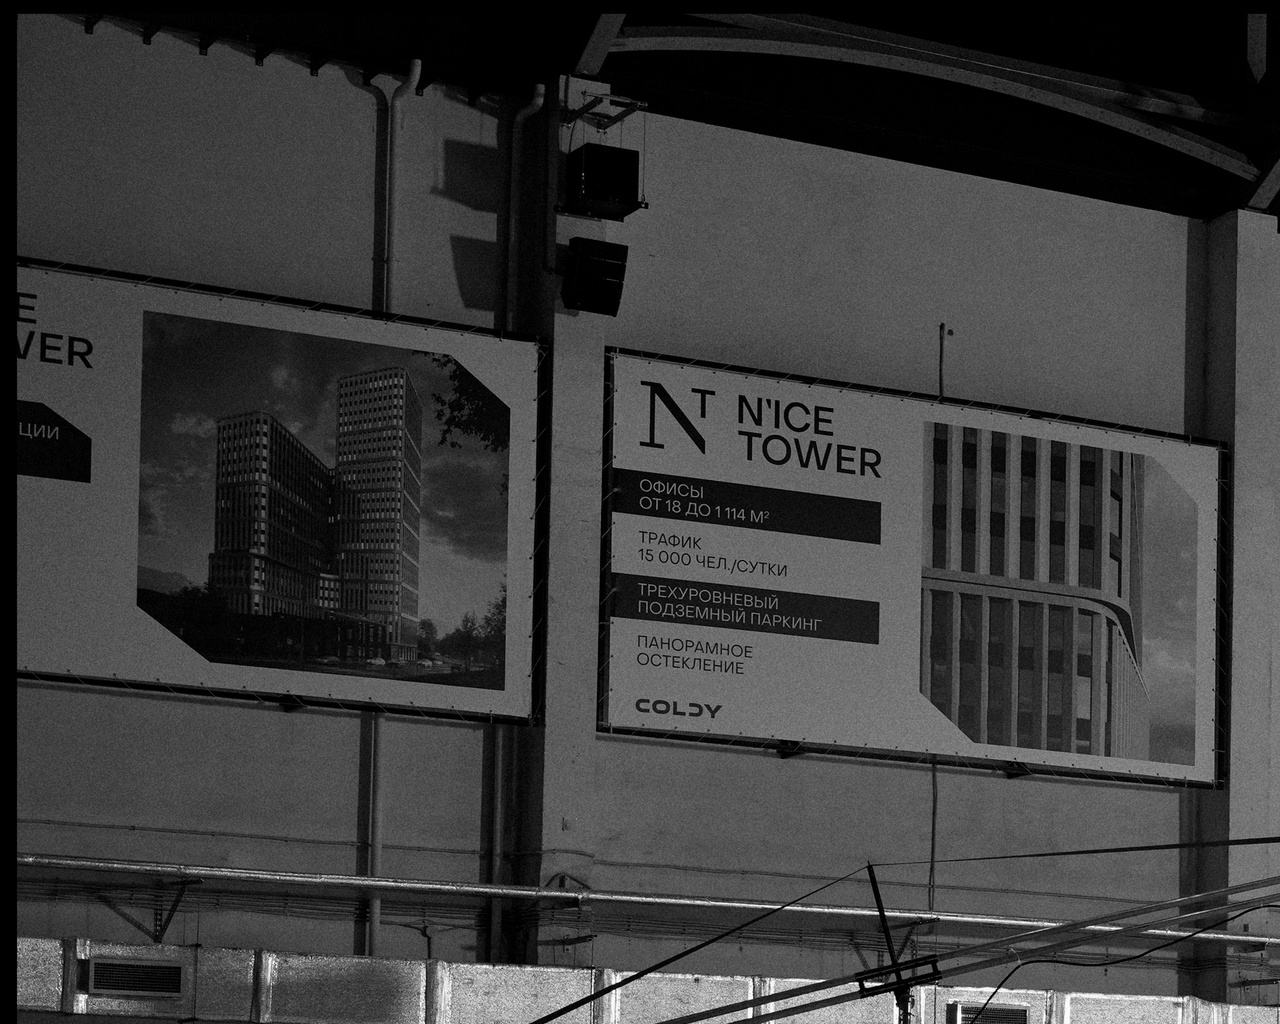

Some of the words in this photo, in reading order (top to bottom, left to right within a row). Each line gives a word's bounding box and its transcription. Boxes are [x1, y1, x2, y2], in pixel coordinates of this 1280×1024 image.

[737, 430, 882, 479] TOWER
[639, 478, 704, 499] ОФИСЫ
[639, 496, 662, 511] ОТ
[665, 499, 682, 514] 18
[685, 503, 711, 518] ДО
[638, 531, 702, 550] ТРАФИК
[638, 549, 654, 562] 15
[658, 550, 692, 566] 000
[696, 554, 788, 578] ЧЕЛ./СУТКИ
[638, 583, 779, 610] ТРЕХУРОВНЕВЫЙ
[638, 601, 747, 624] ПОДЗЕМНЫЙ
[750, 612, 823, 632] ПАРКИНГ
[637, 635, 753, 659] ПАНОРАМНОЕ
[636, 653, 745, 675] ОСТЕКЛЕНИЕ
[635, 698, 723, 719] COLDY
